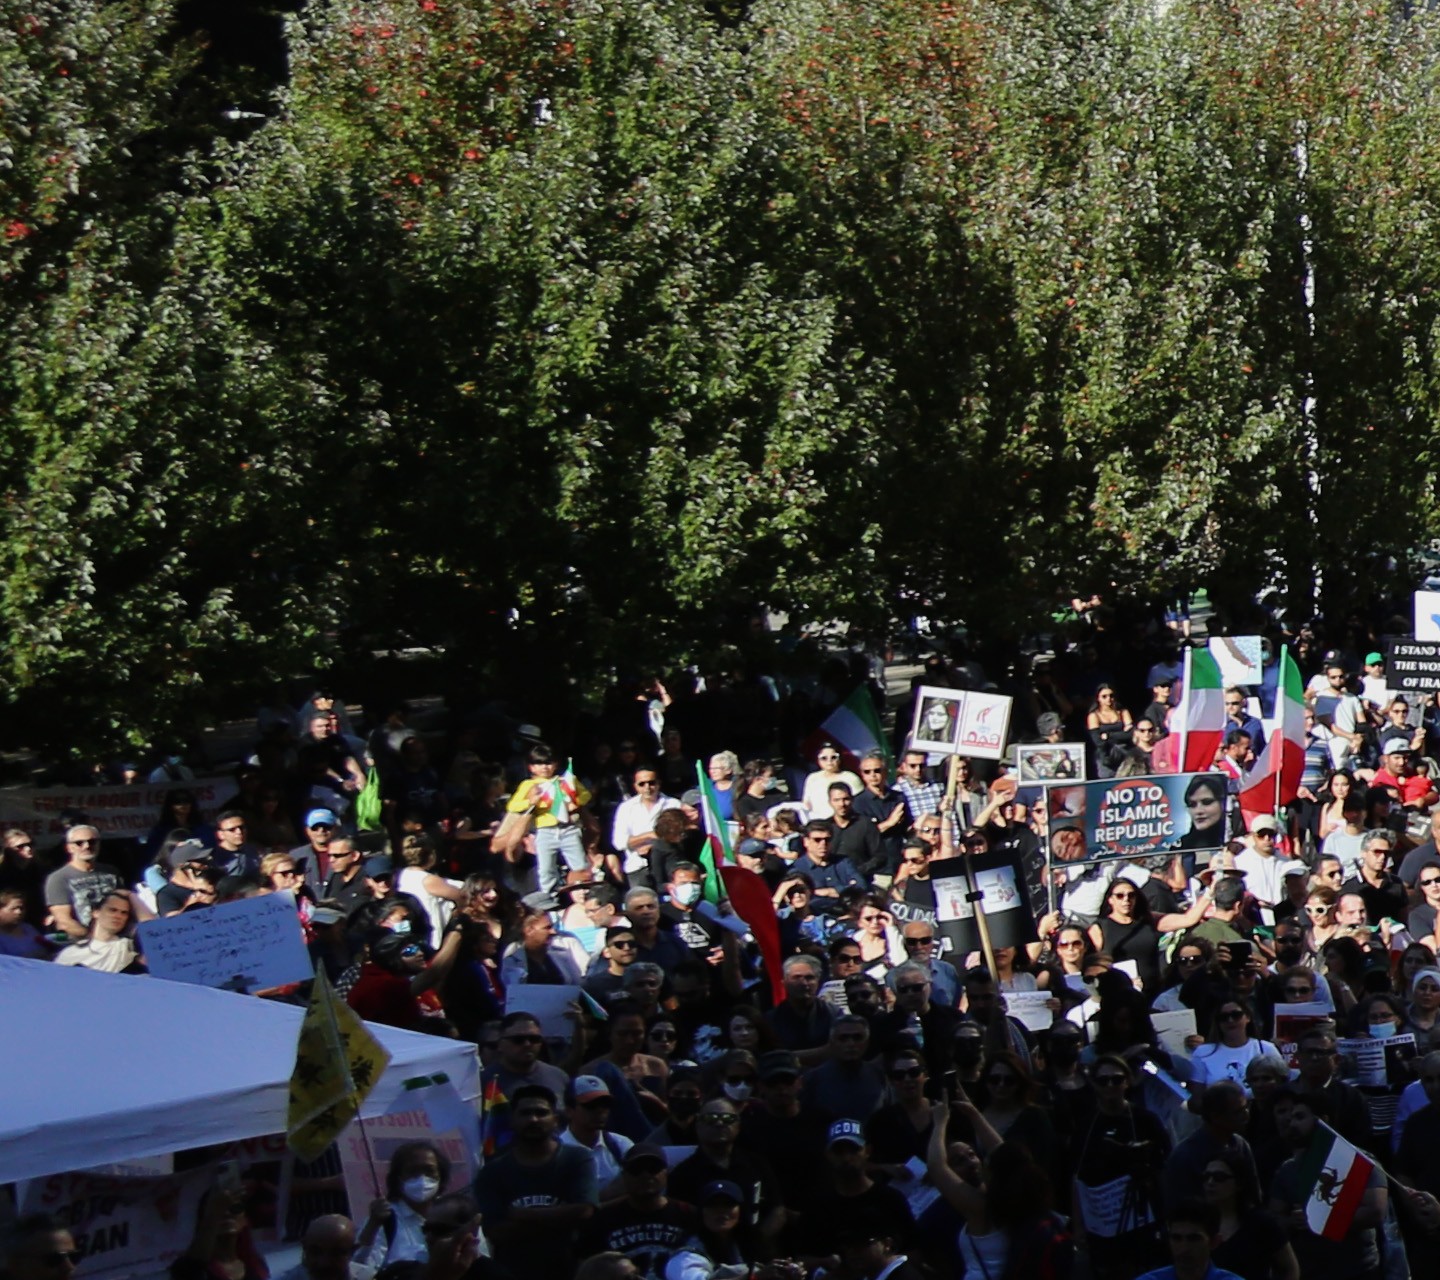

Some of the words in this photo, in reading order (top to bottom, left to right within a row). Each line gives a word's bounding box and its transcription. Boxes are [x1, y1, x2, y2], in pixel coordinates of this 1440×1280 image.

[1401, 646, 1435, 657] STAND
[1395, 661, 1417, 671] THE
[1403, 677, 1417, 688] OF
[1106, 789, 1134, 806] NO
[1138, 785, 1164, 802] TO
[1100, 803, 1169, 824] ISLAMIC
[1095, 821, 1174, 844] REPUBLIC
[1386, 1035, 1413, 1045] MATTER
